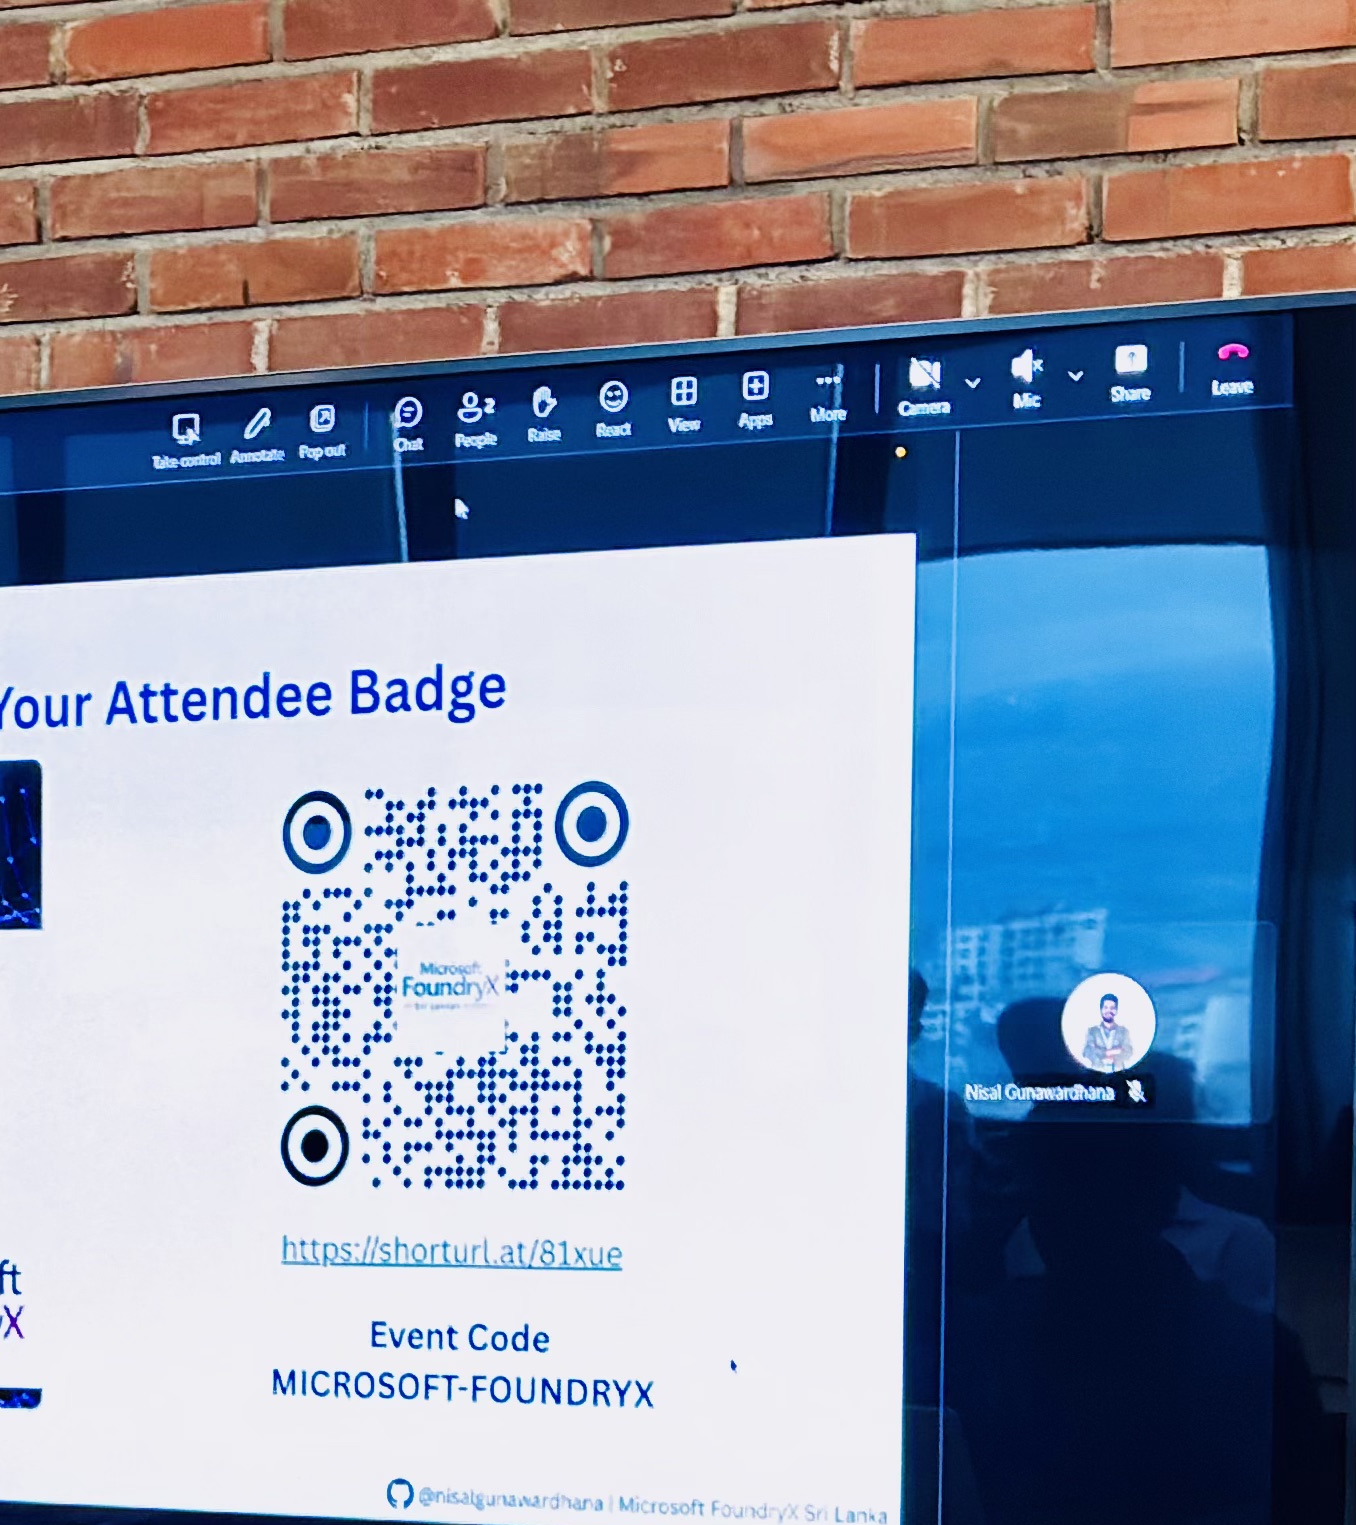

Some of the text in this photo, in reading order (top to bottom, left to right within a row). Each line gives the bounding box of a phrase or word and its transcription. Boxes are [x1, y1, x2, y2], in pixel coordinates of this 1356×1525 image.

[1111, 384, 1151, 403] Share
[1212, 379, 1254, 396] Leave
[483, 396, 497, 414] 2
[898, 400, 951, 418] Camera
[1013, 391, 1041, 410] Mic
[739, 411, 774, 430] Apps
[810, 406, 847, 424] More
[595, 422, 632, 438] React
[668, 417, 702, 433] View
[455, 432, 498, 449] People
[528, 427, 562, 442] Raise
[299, 443, 347, 461] Pop out
[394, 437, 424, 453] Chat
[181, 452, 222, 468] control
[230, 448, 286, 464] Annotate
[105, 670, 333, 728] Attendee
[350, 665, 508, 724] Badge
[419, 961, 482, 976] Microsoft
[402, 974, 499, 1002] FoundryX
[964, 1083, 1116, 1103] Nisal Gunawardhana
[281, 1235, 623, 1271] https://shorturl.at/81xue
[370, 1320, 551, 1354] Event Code
[271, 1368, 655, 1409] MICROSOFT-FOUNDRYX
[418, 1486, 604, 1512] @nisalgunawardhana
[618, 1495, 705, 1517] Microsoft
[711, 1499, 799, 1525] FoundryX
[804, 1503, 829, 1522] Sri
[834, 1506, 888, 1525] Lanka
